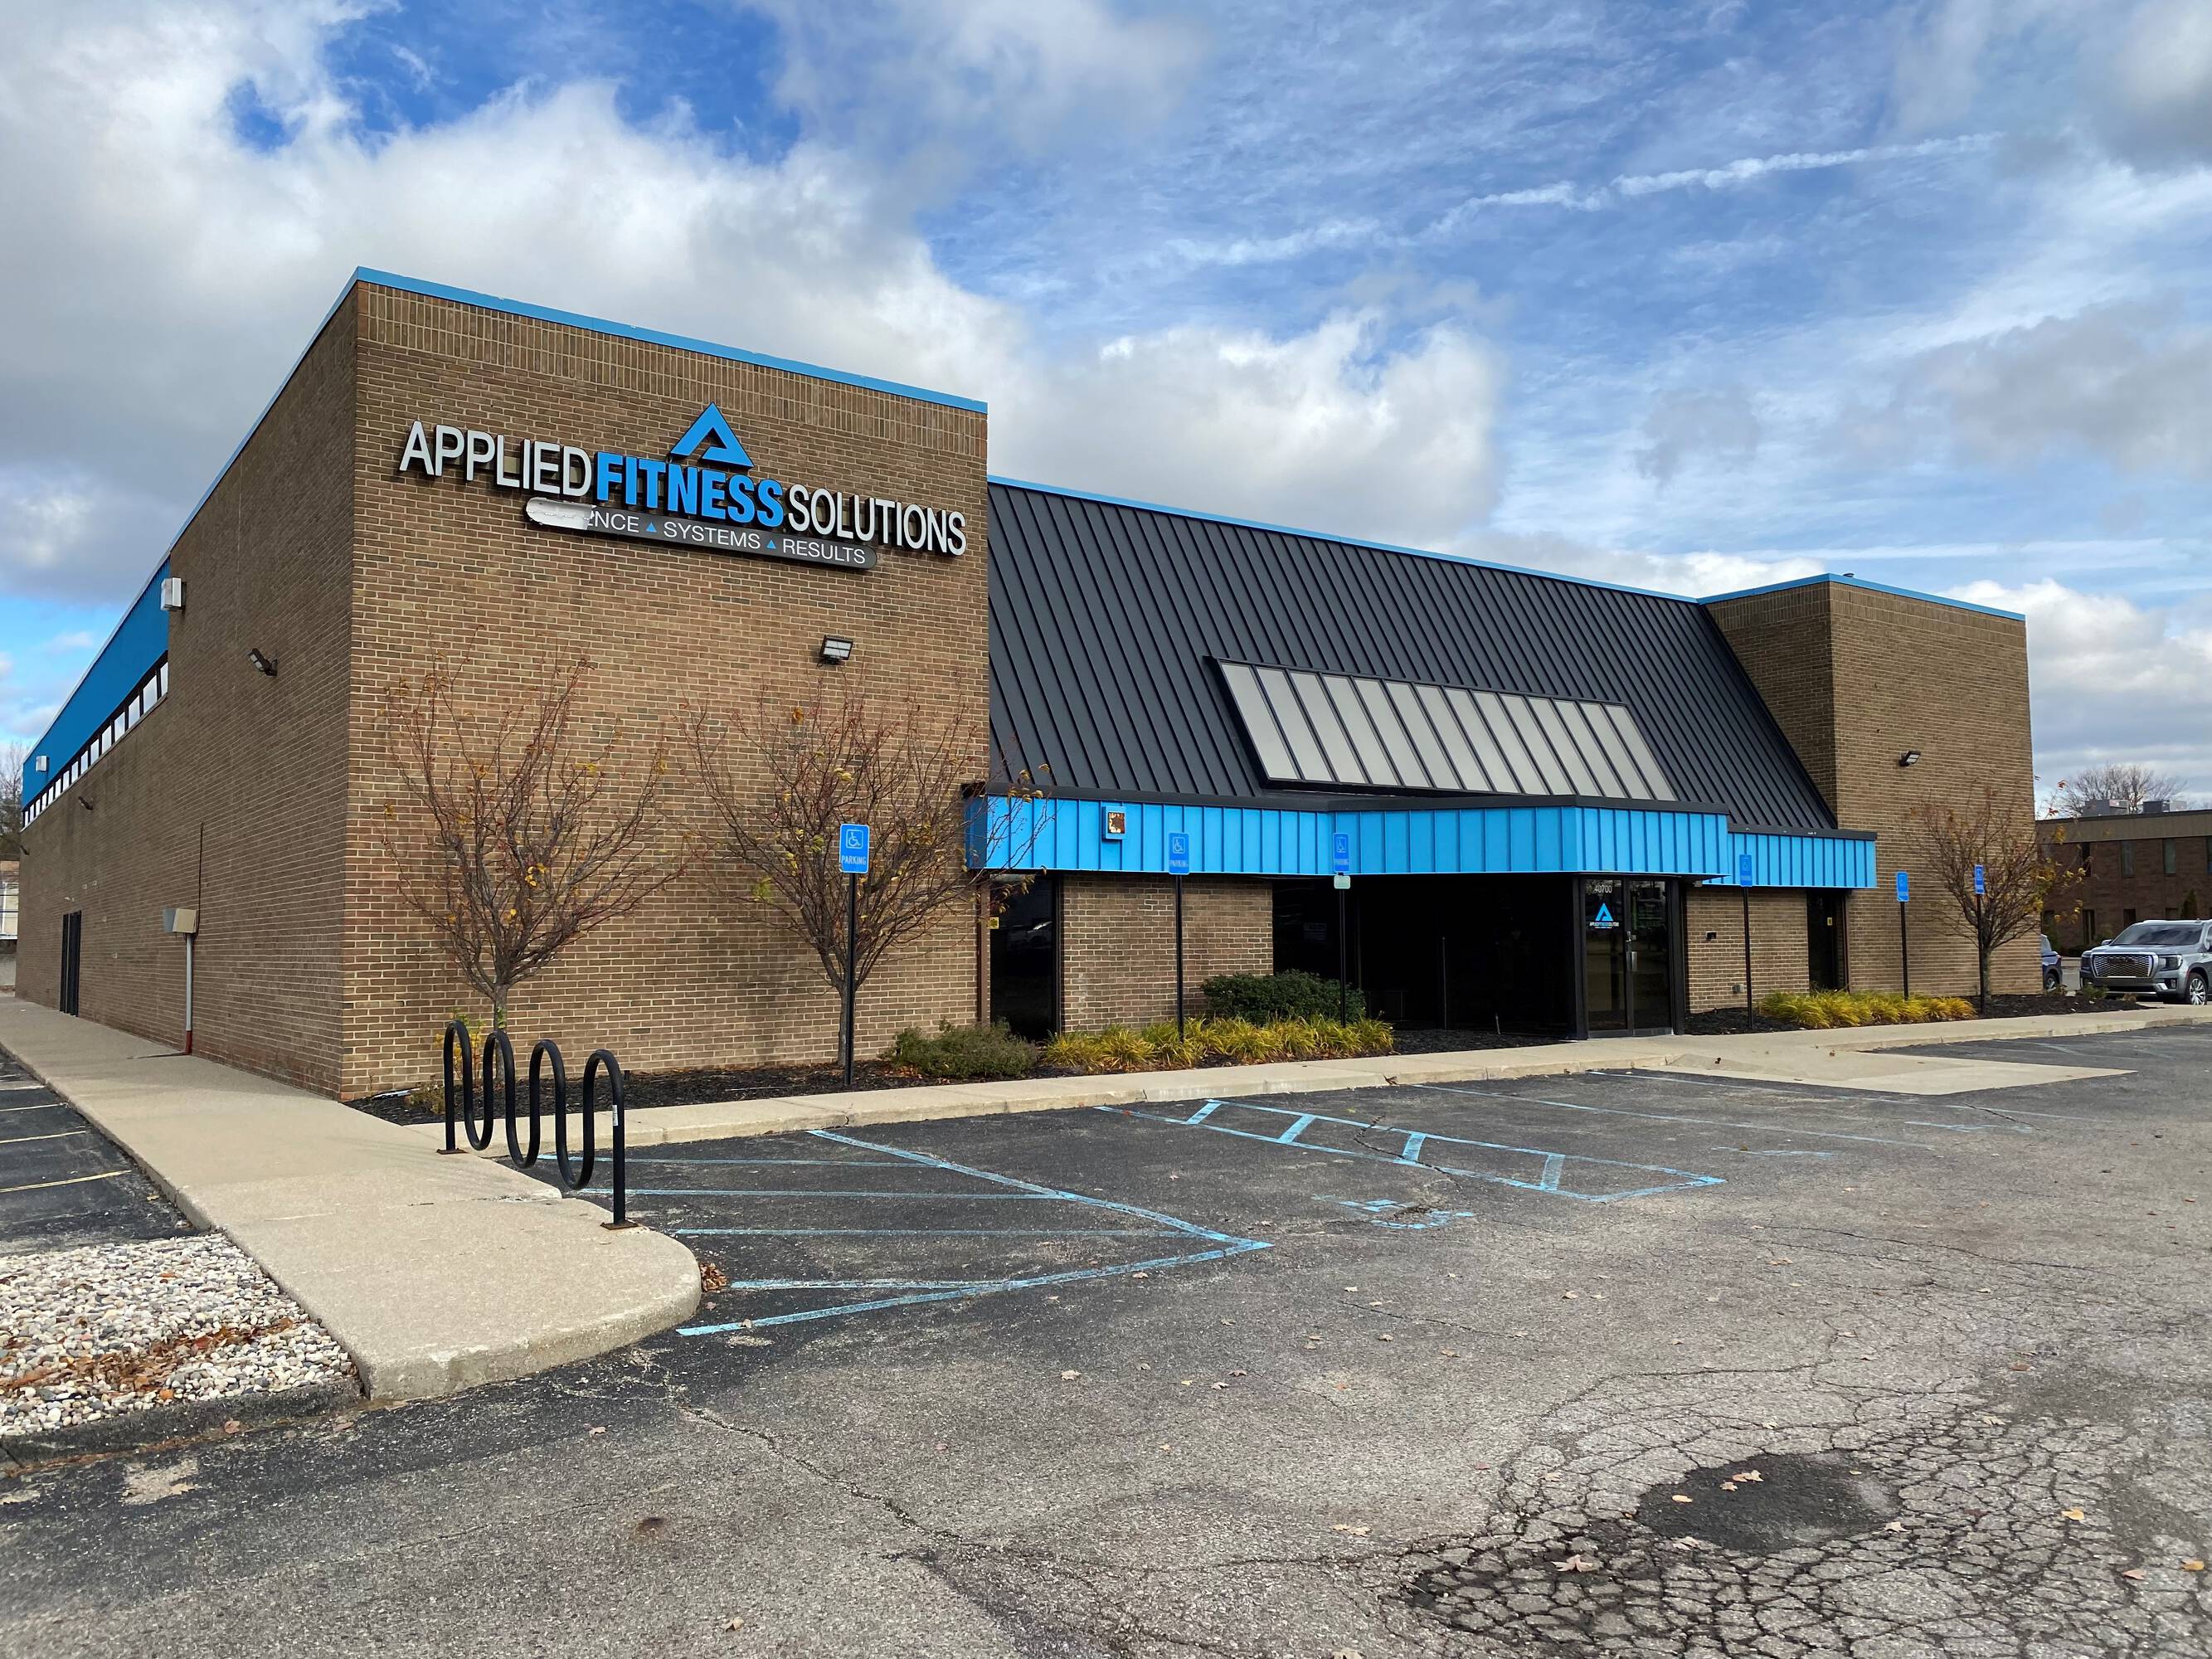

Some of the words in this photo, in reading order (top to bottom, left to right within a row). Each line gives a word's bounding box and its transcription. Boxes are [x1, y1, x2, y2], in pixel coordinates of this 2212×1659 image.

[587, 509, 639, 533] NCE
[663, 521, 762, 551] SYSTEMS
[782, 538, 867, 564] RESULTS
[840, 855, 868, 866] PARKING
[1594, 885, 1612, 893] 40700
